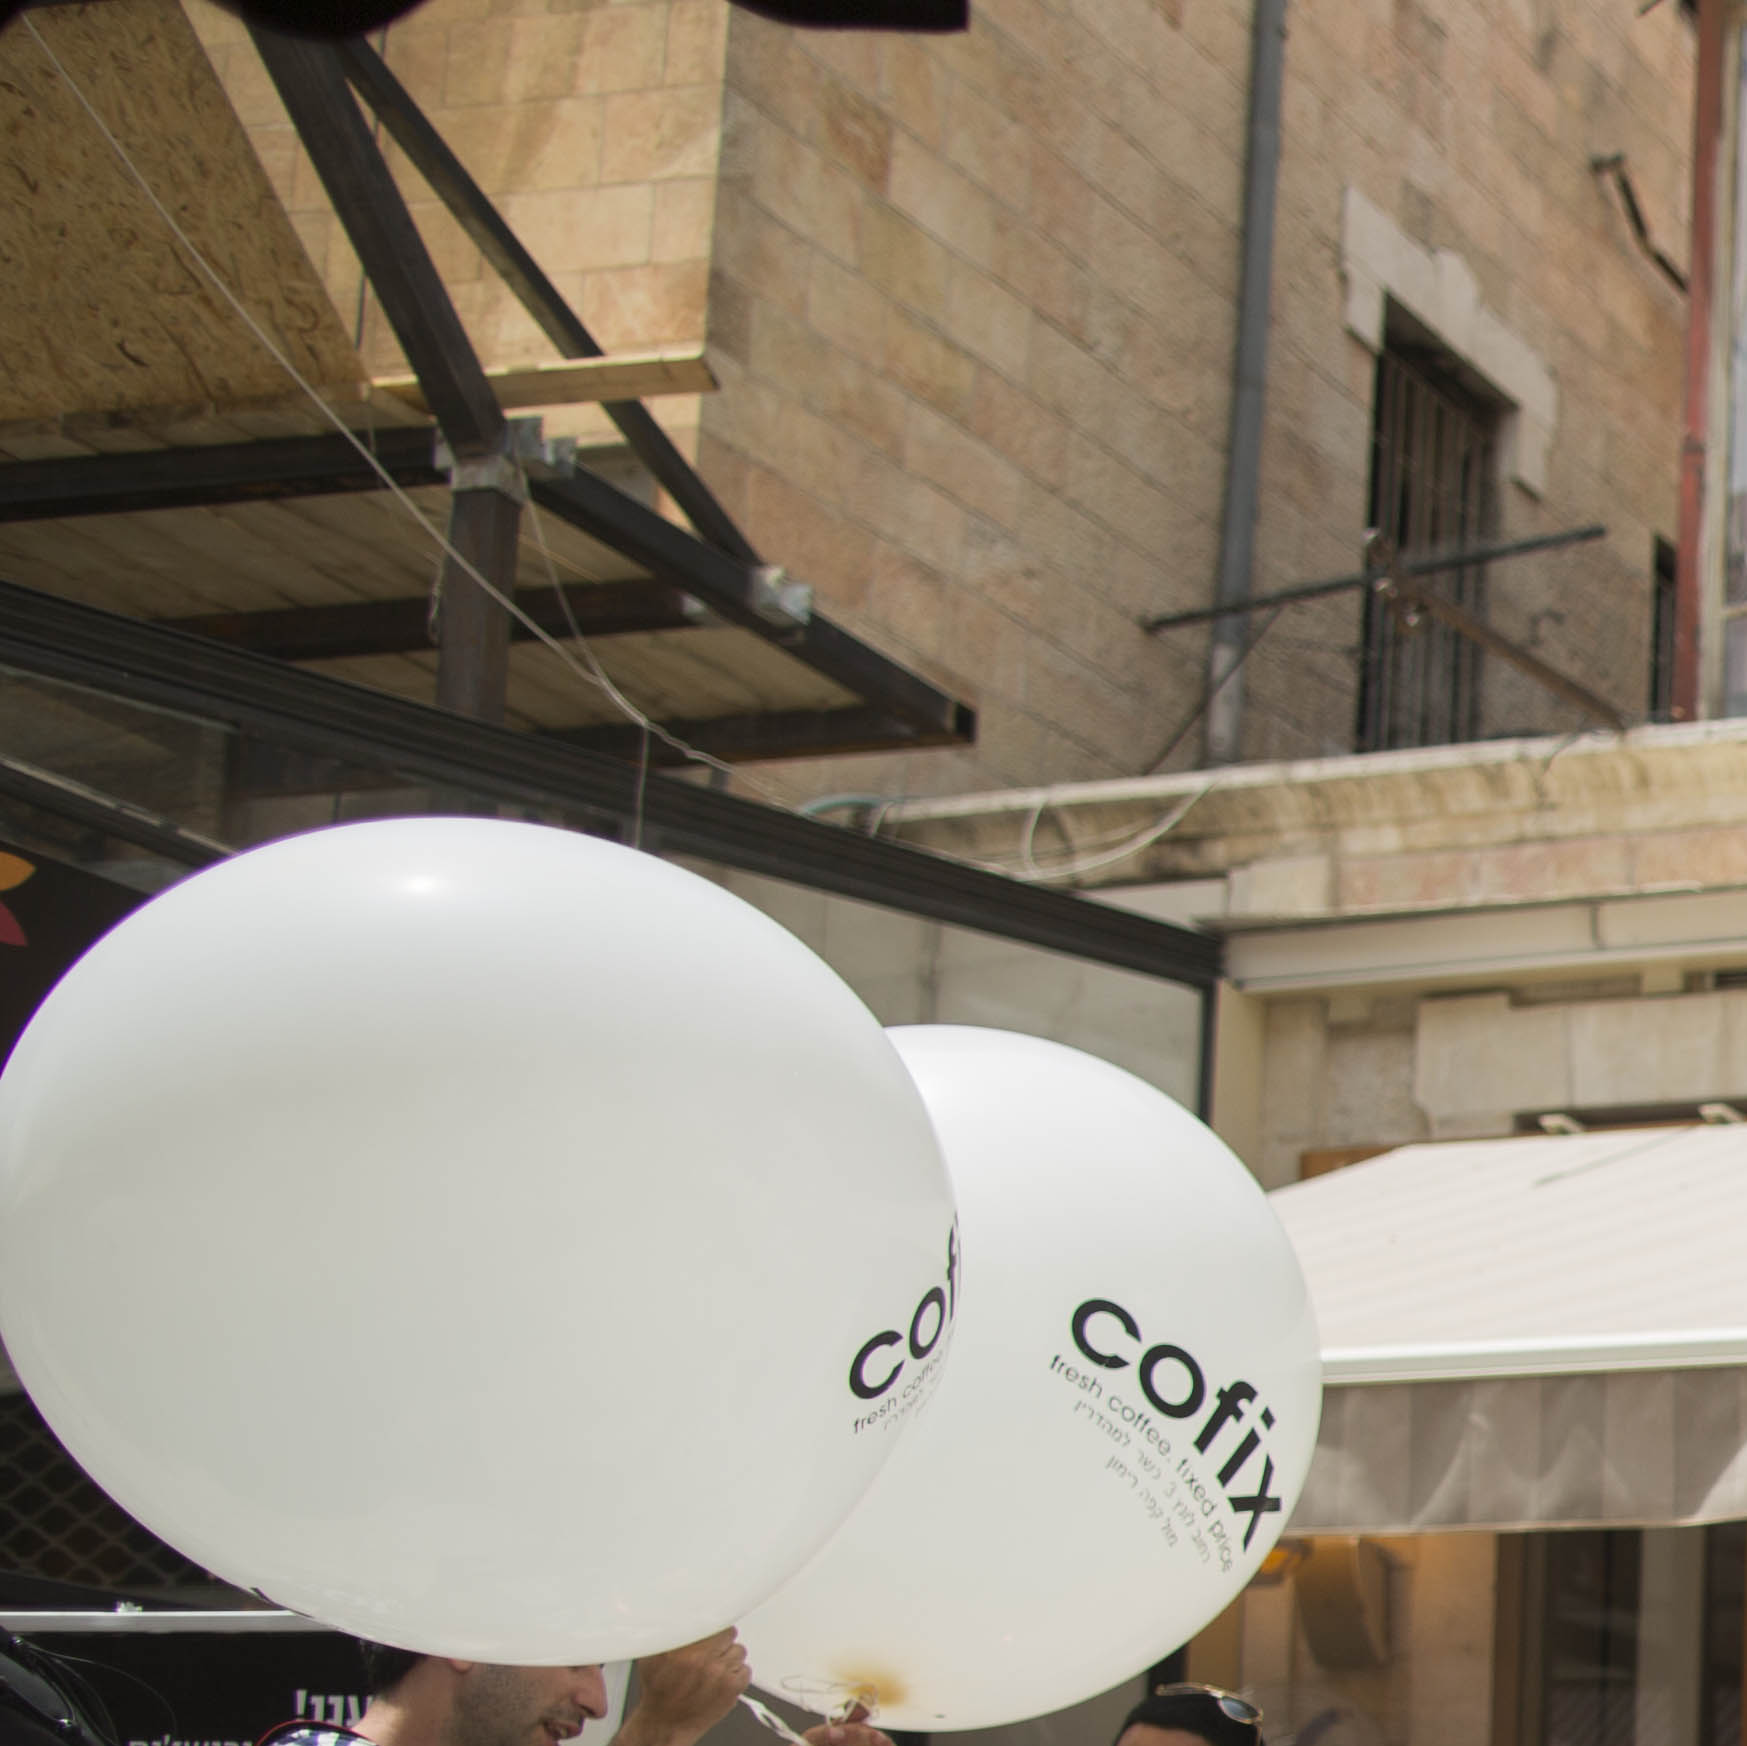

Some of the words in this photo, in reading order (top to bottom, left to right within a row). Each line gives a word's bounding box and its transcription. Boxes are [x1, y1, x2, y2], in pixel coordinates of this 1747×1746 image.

[1050, 1354, 1103, 1399] fresh
[1176, 1457, 1218, 1518] fixed
[1070, 1297, 1282, 1553] cofix
